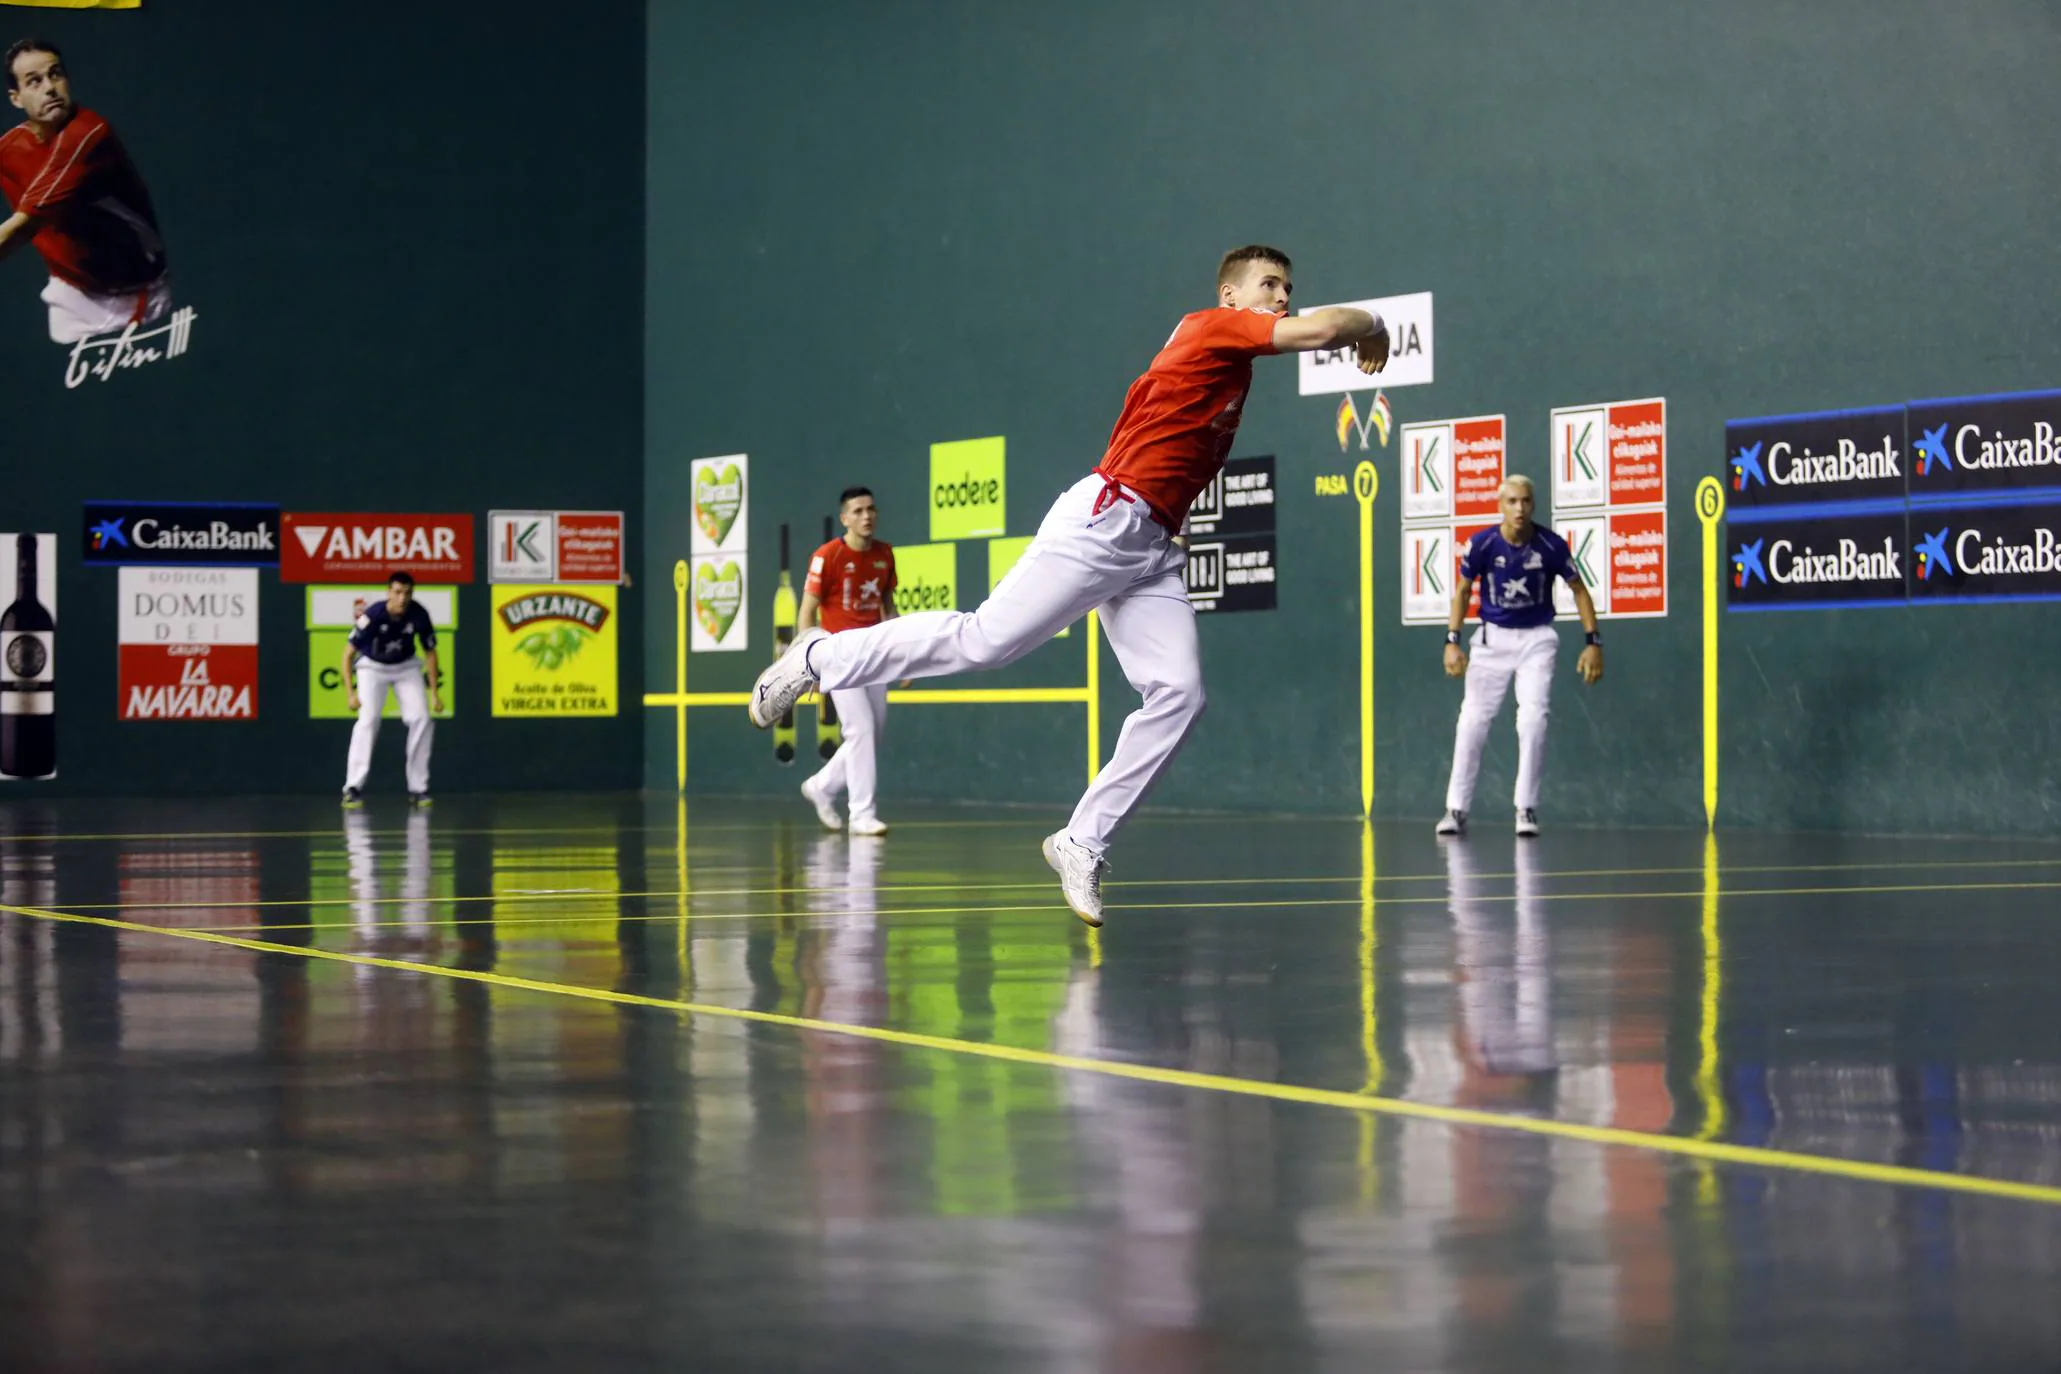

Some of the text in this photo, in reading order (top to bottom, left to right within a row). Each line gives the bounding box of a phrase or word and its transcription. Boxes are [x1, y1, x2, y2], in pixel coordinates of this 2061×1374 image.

[1768, 435, 1901, 485] CaixaBank
[934, 471, 999, 509] codere
[1315, 474, 1347, 496] PASA
[1360, 470, 1371, 496] 7
[1703, 487, 1717, 511] 6
[132, 519, 275, 550] CaixaBank
[324, 526, 459, 560] AMBAR
[1769, 536, 1902, 583] CaixaBank
[149, 571, 226, 584] BODEGAS
[134, 592, 244, 618] DOMUS
[892, 577, 949, 611] odere
[506, 595, 601, 625] URZANTE
[167, 644, 211, 656] GRUPO
[180, 658, 210, 685] LA
[126, 685, 251, 718] NAVARRA
[513, 682, 597, 694] Aceite de Oliva
[502, 697, 608, 711] VIRGEN EXTRA
